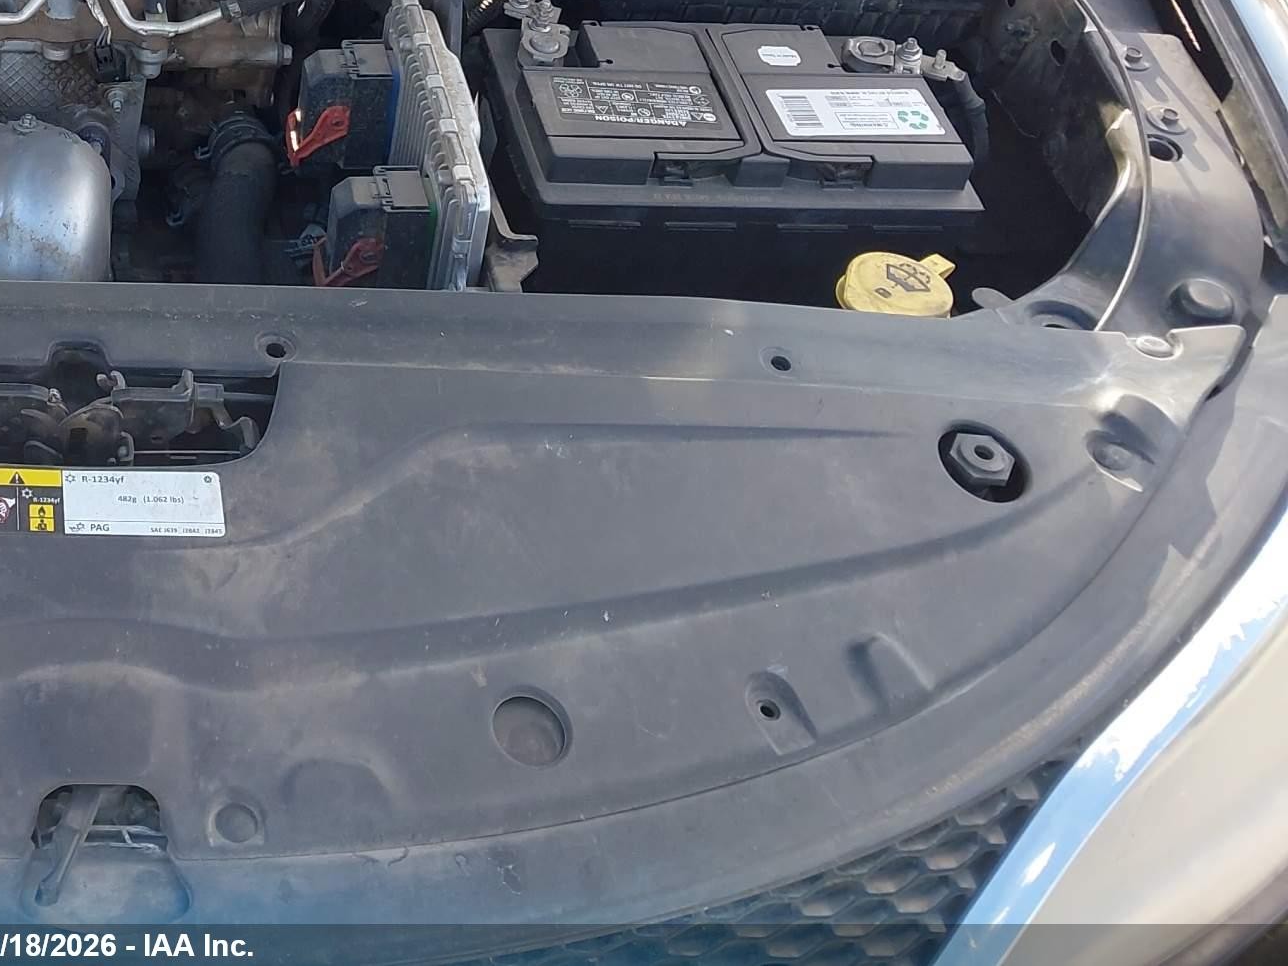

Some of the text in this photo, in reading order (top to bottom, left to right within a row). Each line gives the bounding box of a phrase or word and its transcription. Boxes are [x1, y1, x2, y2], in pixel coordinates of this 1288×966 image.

[81, 475, 124, 485] R-1234yf
[117, 495, 185, 504] 482g (1.062 lbs)
[90, 523, 110, 532] PAG
